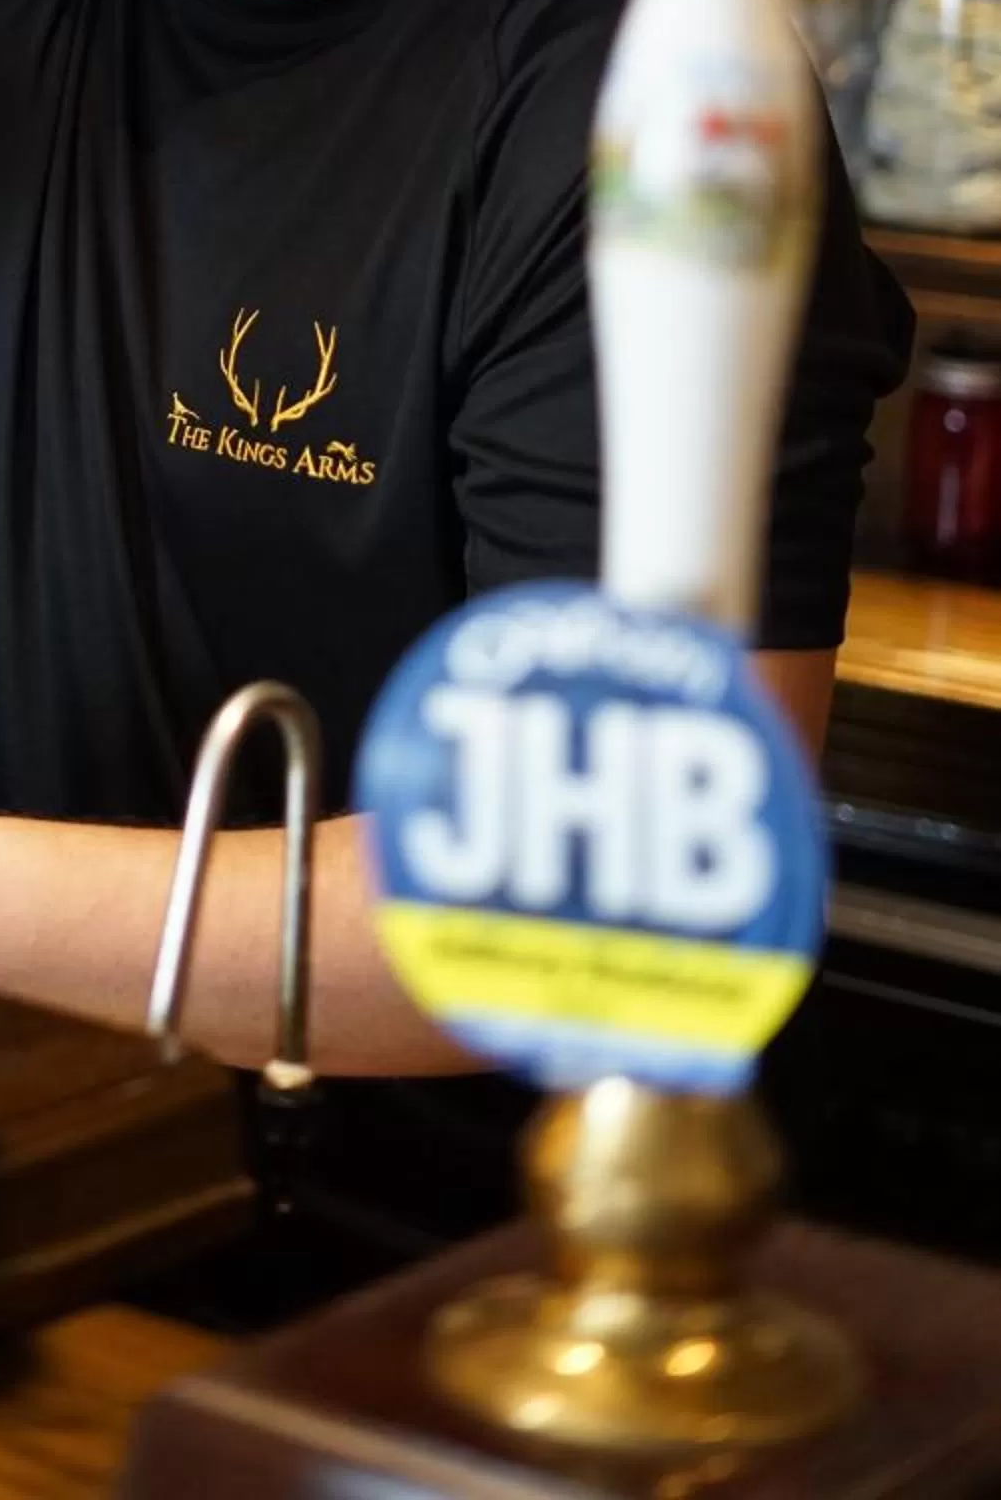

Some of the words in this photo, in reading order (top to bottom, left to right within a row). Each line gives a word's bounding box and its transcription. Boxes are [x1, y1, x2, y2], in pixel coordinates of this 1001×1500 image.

[167, 412, 212, 451] THE
[215, 423, 288, 470] KINGS
[291, 444, 377, 485] ARMS
[403, 682, 779, 934] JHB
